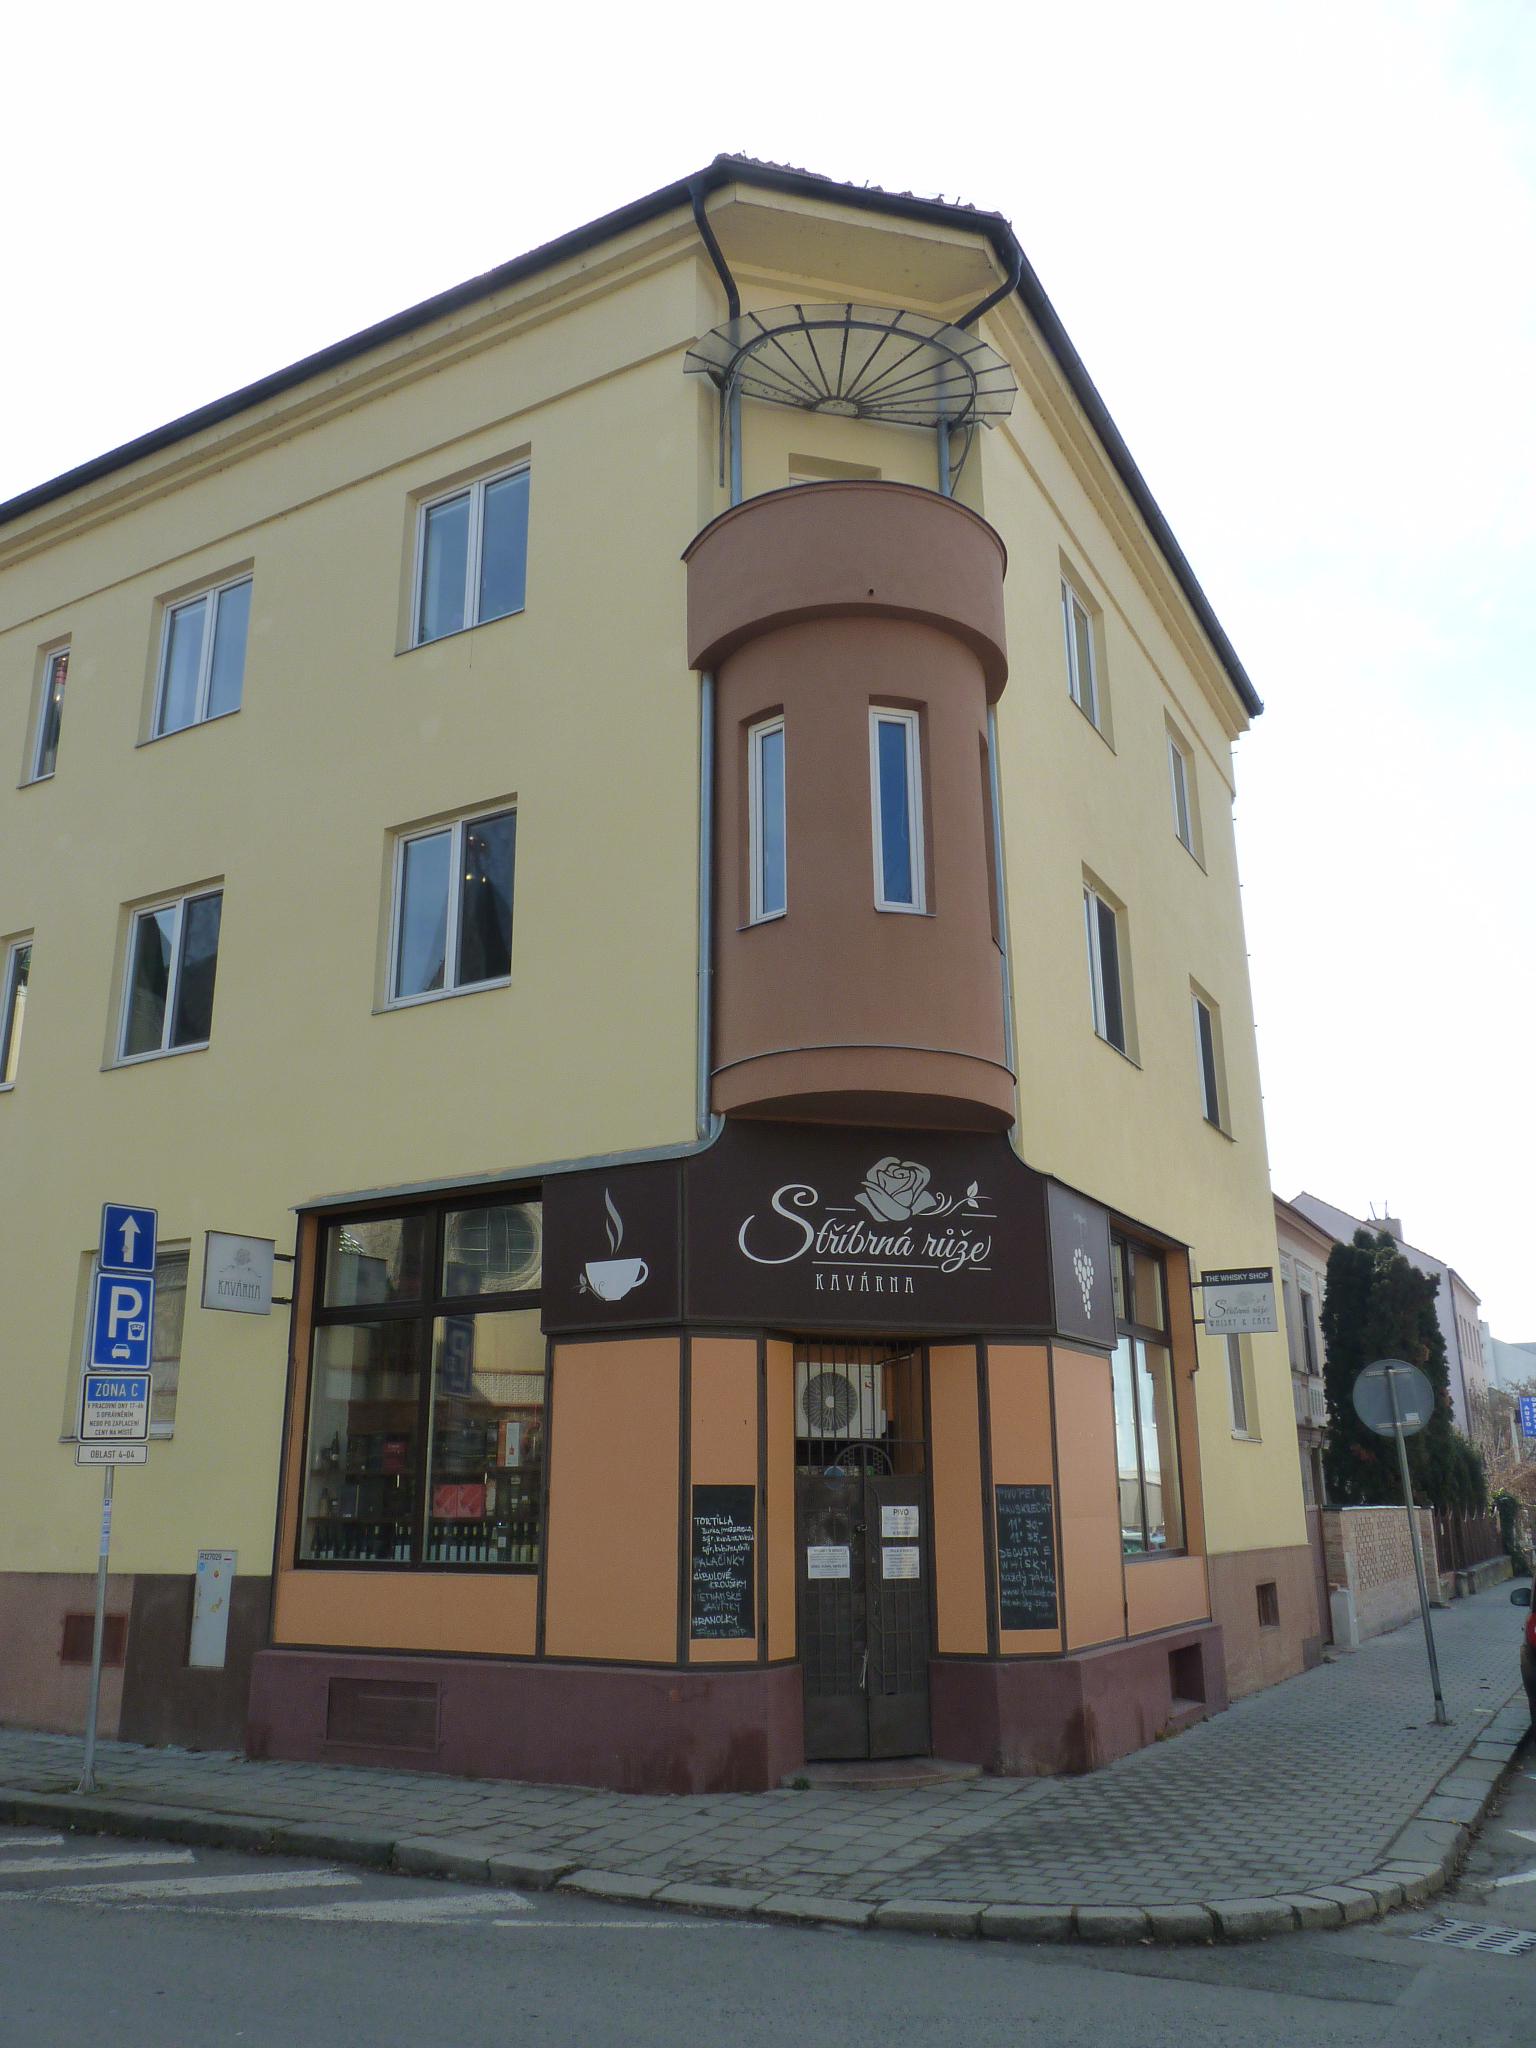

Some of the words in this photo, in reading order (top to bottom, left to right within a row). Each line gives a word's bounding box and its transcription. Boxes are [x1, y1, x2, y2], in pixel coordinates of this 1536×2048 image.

[739, 1184, 914, 1264] Stříbrná
[922, 1227, 992, 1273] růže
[815, 1271, 915, 1294] KAVÁRNA
[1205, 1275, 1220, 1283] THE
[1220, 1273, 1248, 1281] WHISKY
[1248, 1272, 1269, 1280] SHOP
[108, 1285, 142, 1338] P
[95, 1380, 127, 1397] ZÓNA
[131, 1383, 139, 1397] C
[112, 1419, 140, 1427] ZAPLACENÍ
[90, 1449, 116, 1459] OBLAST
[118, 1450, 135, 1458] 4-04
[893, 1508, 910, 1516] PIVO
